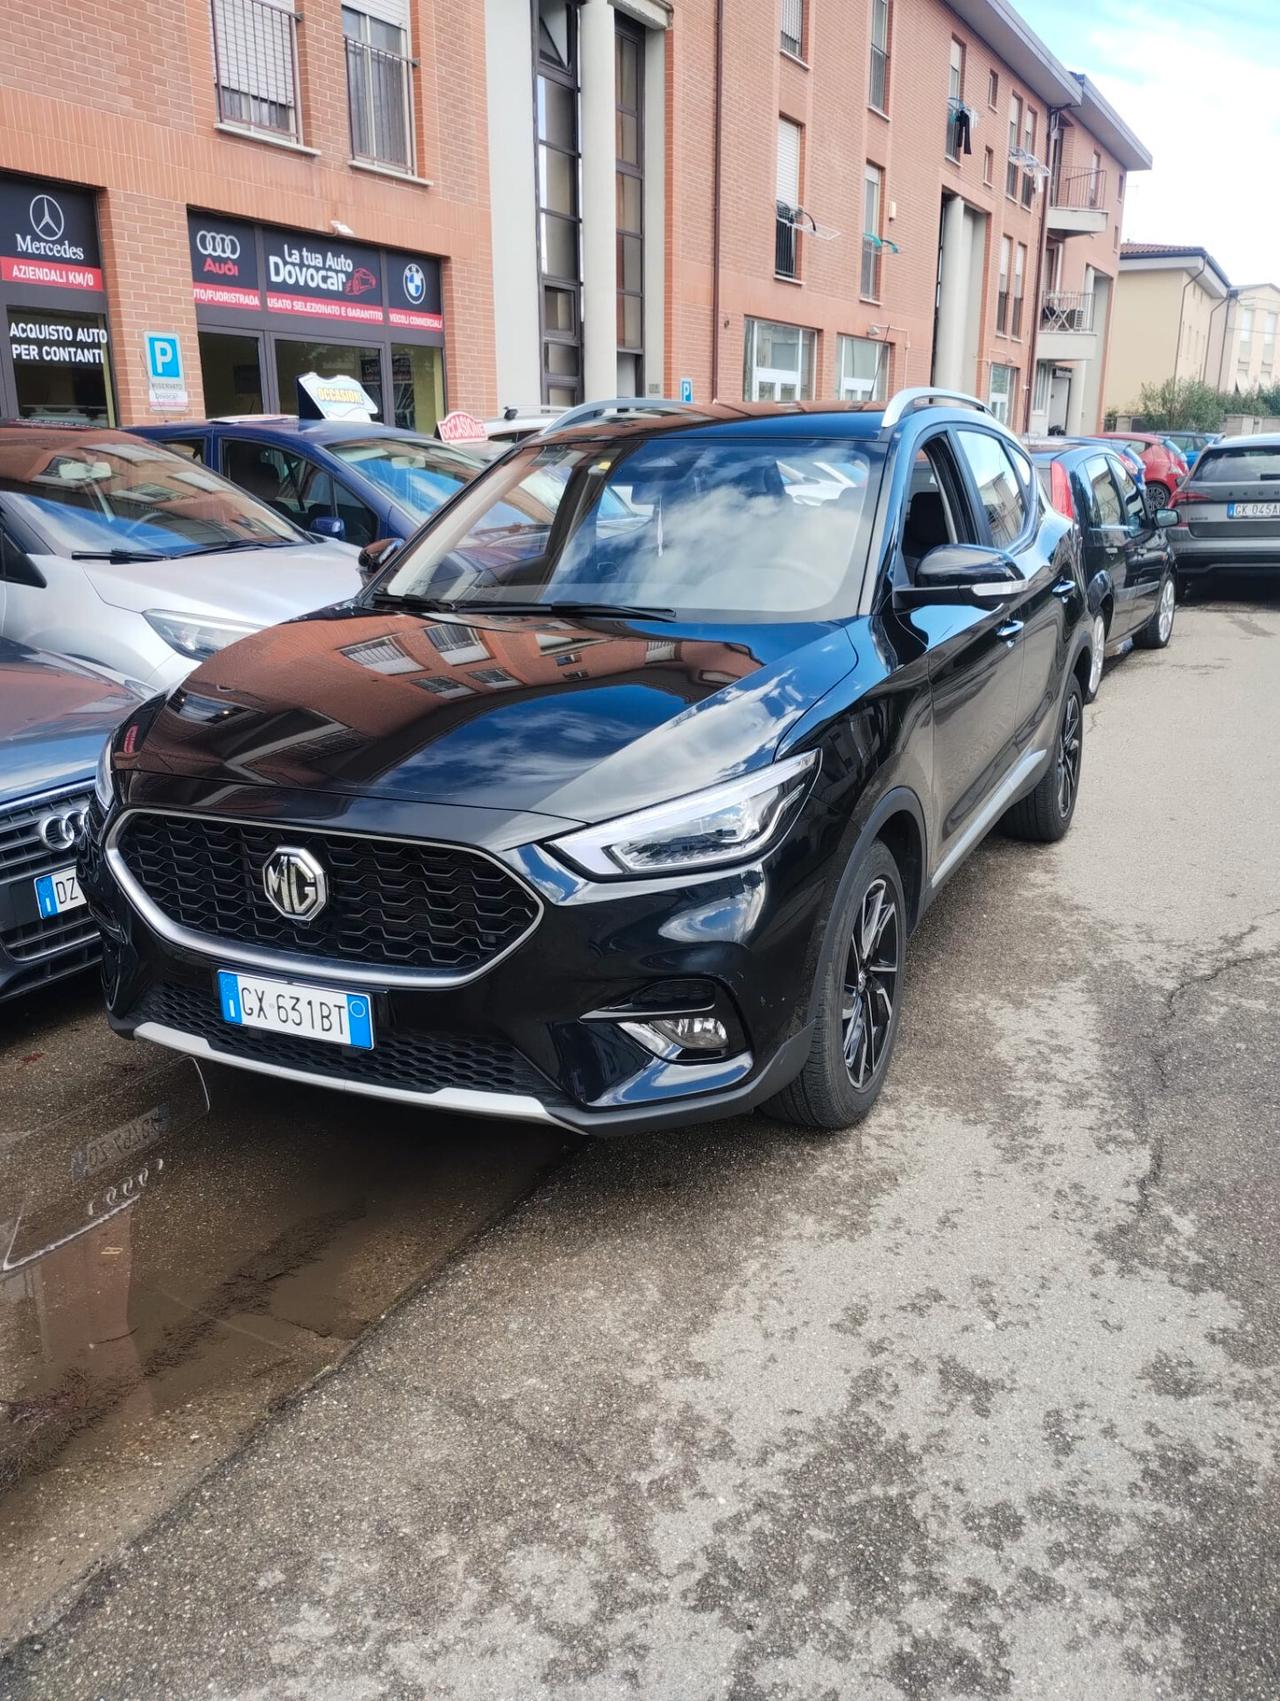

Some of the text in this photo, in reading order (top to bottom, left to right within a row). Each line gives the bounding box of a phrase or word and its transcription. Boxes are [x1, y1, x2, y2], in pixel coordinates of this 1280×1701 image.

[15, 233, 85, 260] Mercedes
[284, 244, 353, 272] La tua Auto
[12, 264, 66, 283] AZIENDALI
[203, 257, 239, 276] Audi
[269, 255, 346, 291] Dovocar
[267, 297, 383, 321] USATO SELEZIONATO E GARANTITO
[389, 313, 442, 329] VEICOLI COMMERCIALI
[9, 322, 107, 344] ACQUISTO AUTO
[12, 344, 104, 363] PER CONTANTI
[154, 341, 173, 373] P
[441, 415, 485, 440] OCCASIONE
[1251, 502, 1280, 514] 045A
[56, 877, 79, 904] DZ
[267, 855, 317, 913] MG
[241, 987, 268, 1020] GX
[276, 994, 345, 1035] 631BT
